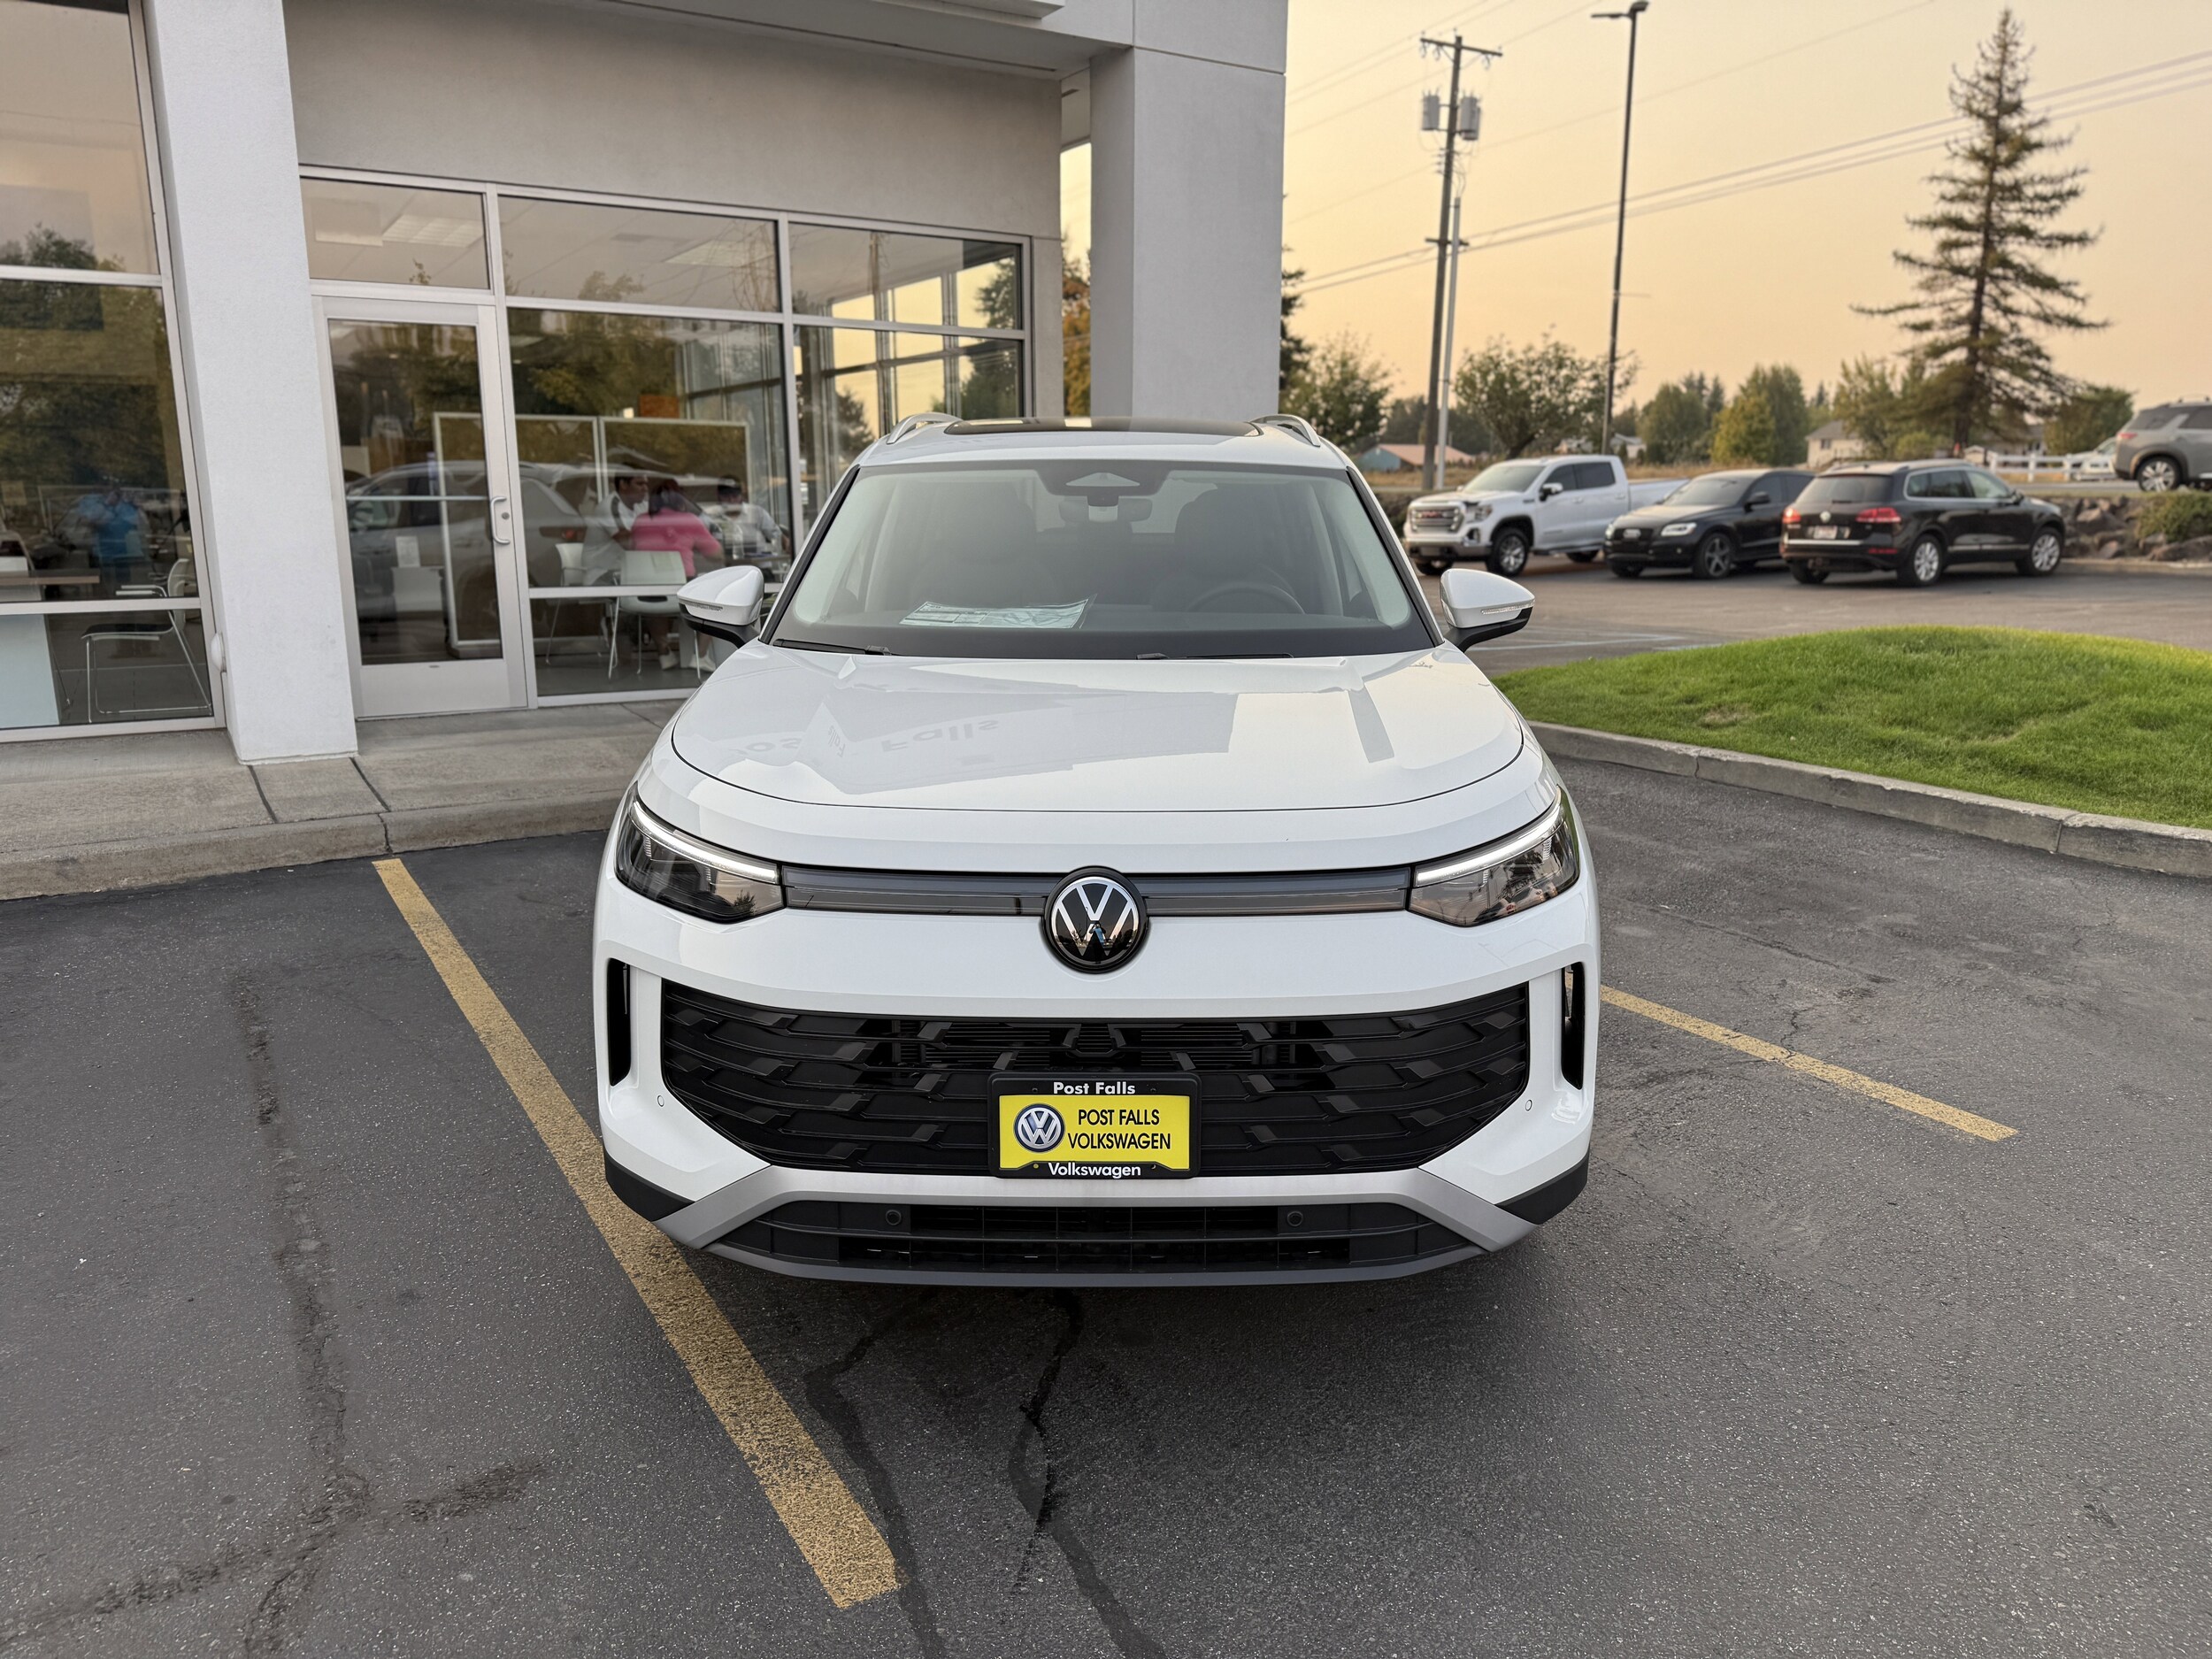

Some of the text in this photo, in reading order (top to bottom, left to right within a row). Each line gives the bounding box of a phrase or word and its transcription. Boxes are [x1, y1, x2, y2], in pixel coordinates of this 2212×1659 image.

[1053, 1081, 1136, 1094] Post Falls
[1078, 1109, 1160, 1125] POST FALLS
[1067, 1133, 1171, 1149] VOLKSWAGEN
[1048, 1162, 1141, 1179] Volkswagen
